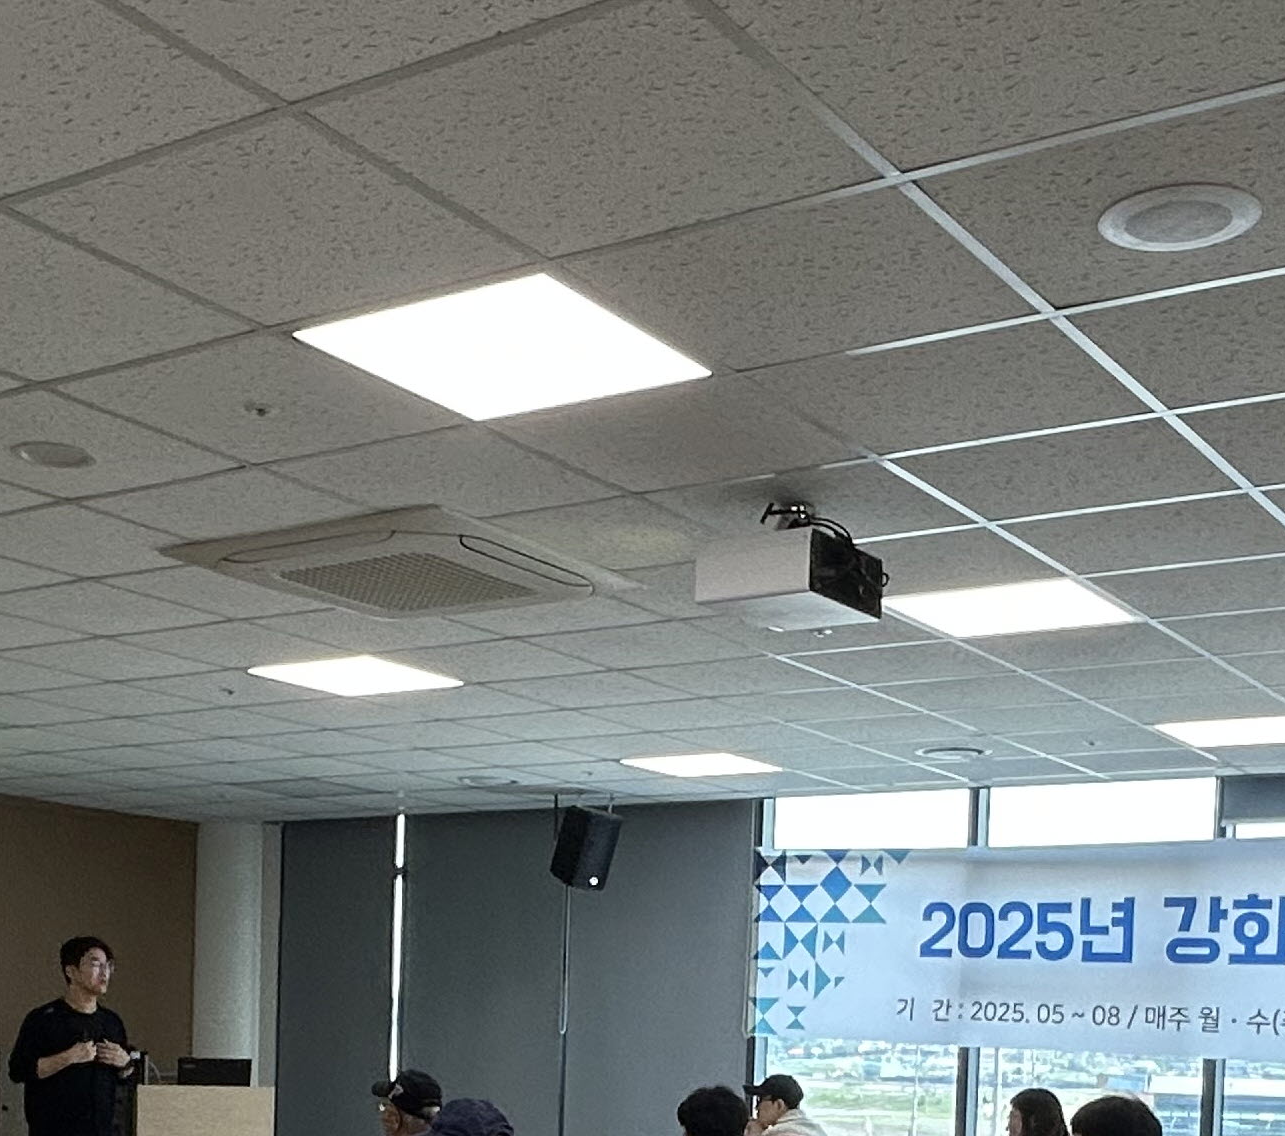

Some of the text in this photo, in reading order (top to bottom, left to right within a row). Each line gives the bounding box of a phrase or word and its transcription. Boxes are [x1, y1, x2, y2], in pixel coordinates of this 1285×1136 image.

[919, 896, 1136, 964] 2025년
[1092, 1004, 1121, 1026] 08
[1144, 1005, 1191, 1032] 매주
